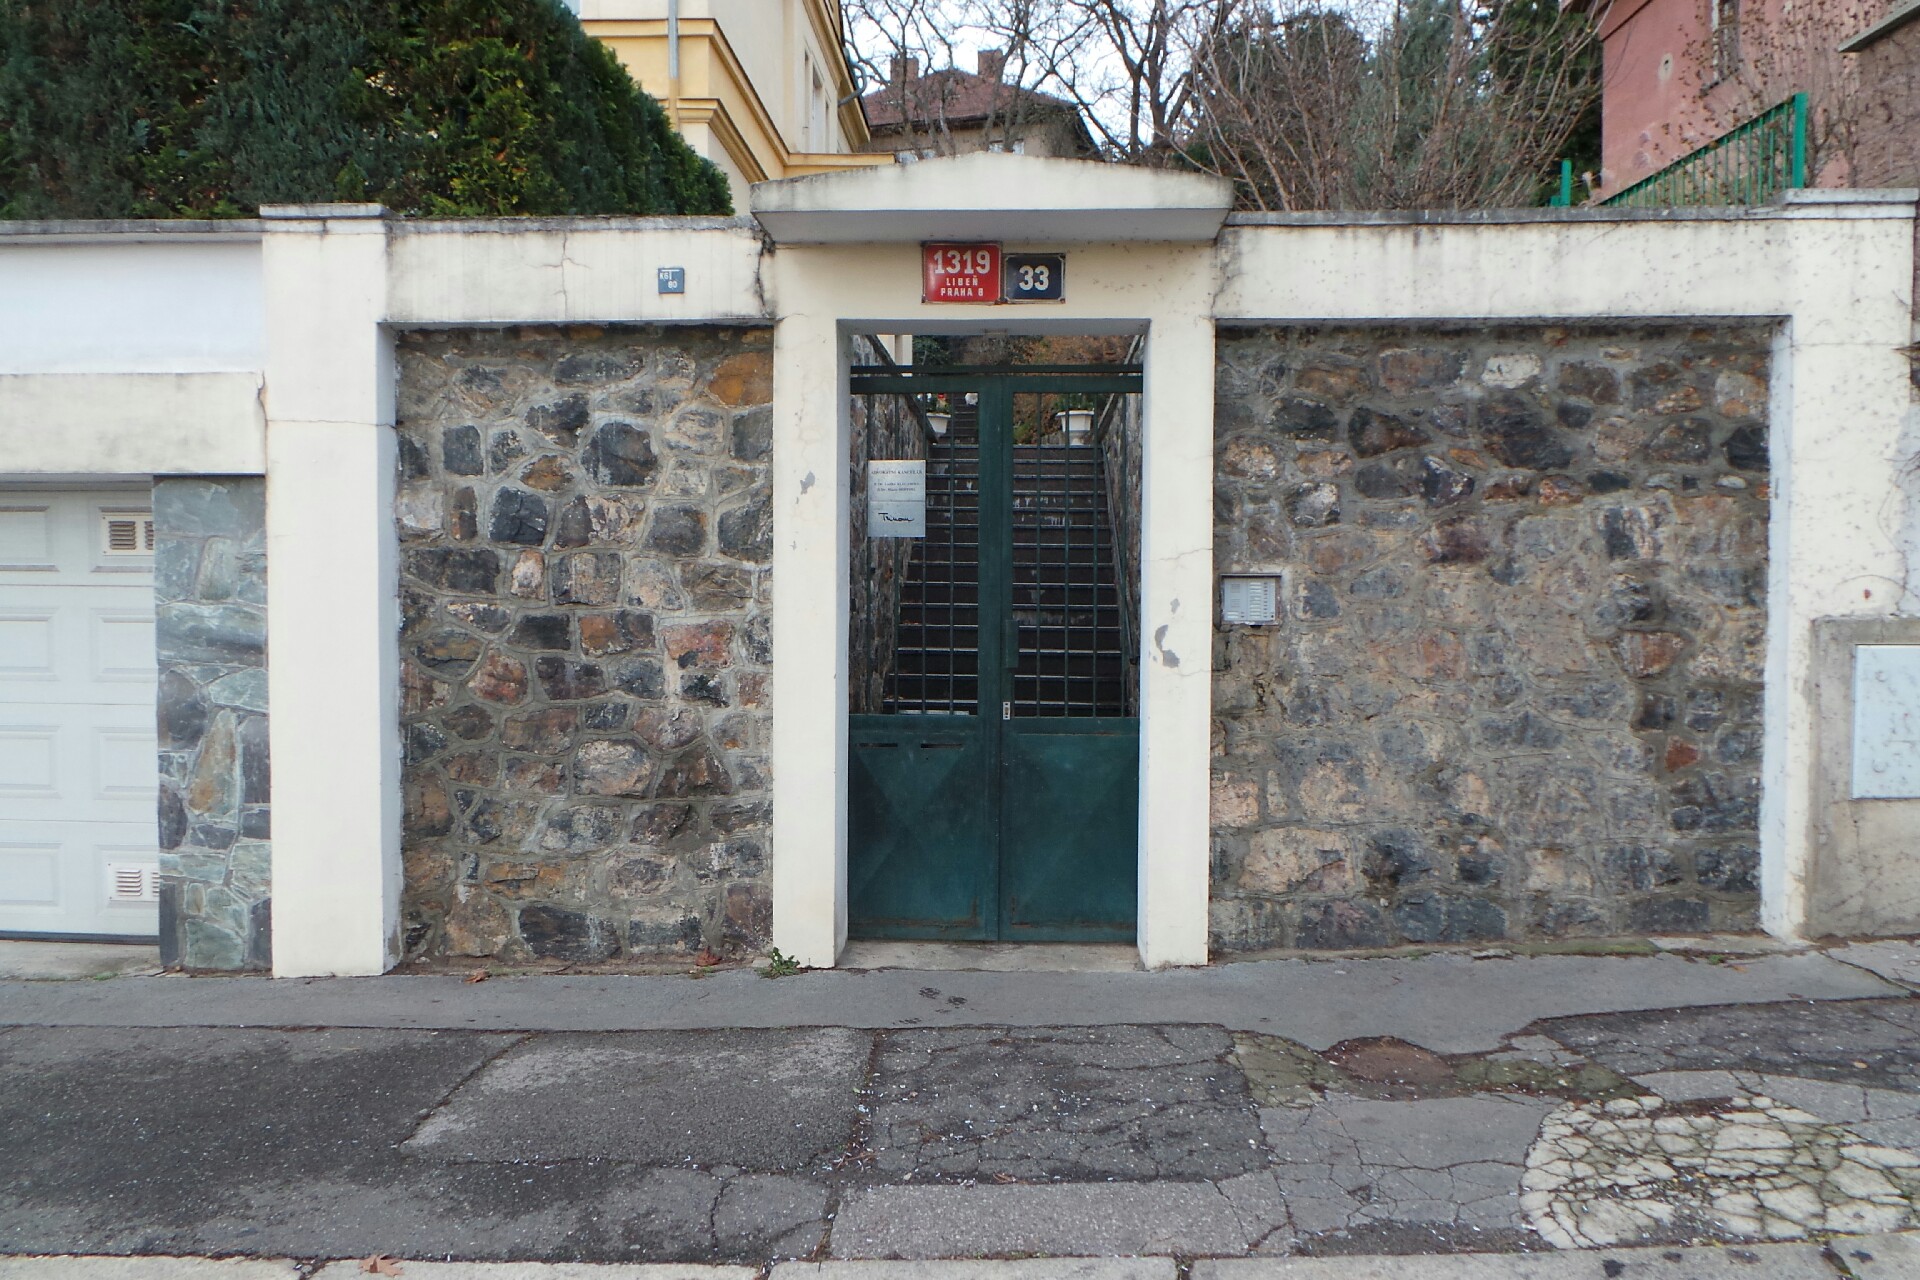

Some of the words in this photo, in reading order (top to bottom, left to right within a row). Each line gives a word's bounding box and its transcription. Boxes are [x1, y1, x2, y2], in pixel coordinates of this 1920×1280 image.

[933, 249, 991, 274] 1319
[946, 275, 978, 286] LIBEŇ
[1018, 265, 1050, 291] 33
[940, 288, 973, 297] PRAHA
[978, 288, 984, 297] 8
